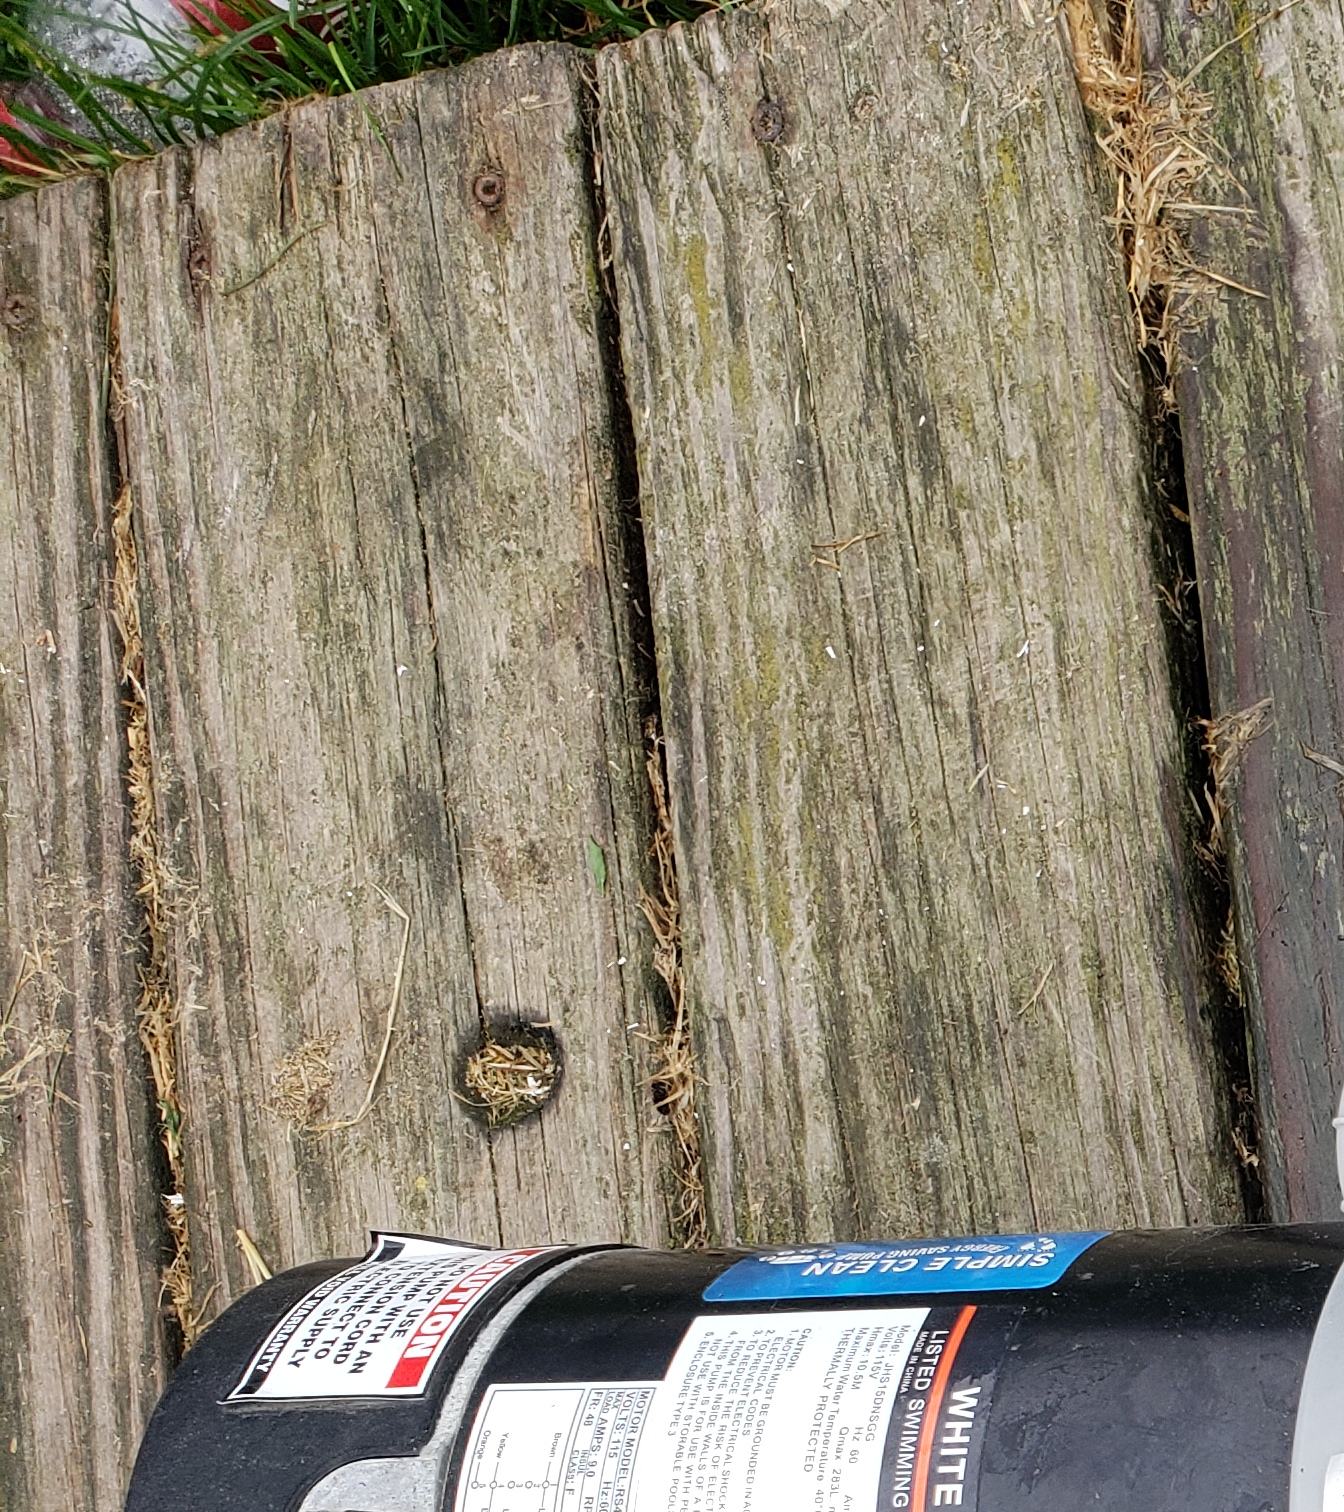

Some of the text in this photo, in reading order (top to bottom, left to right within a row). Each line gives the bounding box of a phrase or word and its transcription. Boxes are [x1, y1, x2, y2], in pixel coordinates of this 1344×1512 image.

[800, 1252, 1056, 1275] SIMPLE CLEAN
[832, 1244, 952, 1261] SAVING PUMP
[309, 1272, 402, 1360] CONNECT TO
[388, 1264, 475, 1339] DO NOT USE
[402, 1255, 529, 1359] CAUTION
[251, 1275, 348, 1372] VOID WARRANTY
[282, 1307, 340, 1368] SUPPLY
[346, 1270, 446, 1374] PUMP WITH AN
[329, 1318, 375, 1364] CORD
[706, 1338, 723, 1356] NOT
[716, 1339, 734, 1360] THIS
[726, 1340, 746, 1366] FROM
[745, 1338, 758, 1350] TO
[757, 1338, 771, 1350] TO
[773, 1337, 795, 1371] MOTOR
[785, 1327, 812, 1372] CAUTION:
[841, 1326, 869, 1371] Maximum
[888, 1324, 911, 1356] Model:
[696, 1360, 712, 1380] USE
[728, 1354, 751, 1394] REDUCE
[739, 1352, 764, 1397] PREVENT
[850, 1359, 868, 1390] 10.5M
[899, 1330, 929, 1393] MADE IN CHINA
[913, 1329, 949, 1390] LISTED
[668, 1340, 710, 1427] ENCLOSURE TYPE
[705, 1364, 722, 1391] PUMP
[717, 1369, 732, 1389] THE
[741, 1336, 784, 1436] ELECTRICAL CODES
[764, 1373, 780, 1400] MUST
[831, 1374, 850, 1404] Water
[583, 1391, 603, 1426] FR: 48
[610, 1391, 623, 1410] MAX
[613, 1391, 636, 1434] VOLTS:
[626, 1390, 650, 1434] MOTOR
[686, 1384, 702, 1409] WITH
[705, 1393, 723, 1428] INSIDE
[720, 1399, 734, 1419] THE
[758, 1403, 770, 1416] BE
[802, 1327, 855, 1472] THERMALLY PROTECTED
[589, 1417, 608, 1456] AMPS:
[692, 1410, 706, 1432] FOR
[713, 1424, 727, 1450] RISK
[722, 1399, 746, 1466] ELECTRICAL
[851, 1426, 864, 1441] Hz
[548, 1432, 562, 1457] Brown
[607, 1438, 620, 1458] 115
[672, 1414, 693, 1472] STORABLE
[697, 1433, 712, 1470] WALLS
[745, 1419, 766, 1484] GROUNDED
[891, 1398, 925, 1508] SWIMMING
[933, 1386, 981, 1506] WHITE
[584, 1460, 597, 1477] 9.0
[681, 1464, 694, 1494] WITH
[710, 1455, 720, 1470] OF
[694, 1475, 704, 1490] OF
[717, 1469, 730, 1510] SHOCK
[744, 1487, 752, 1498] IN
